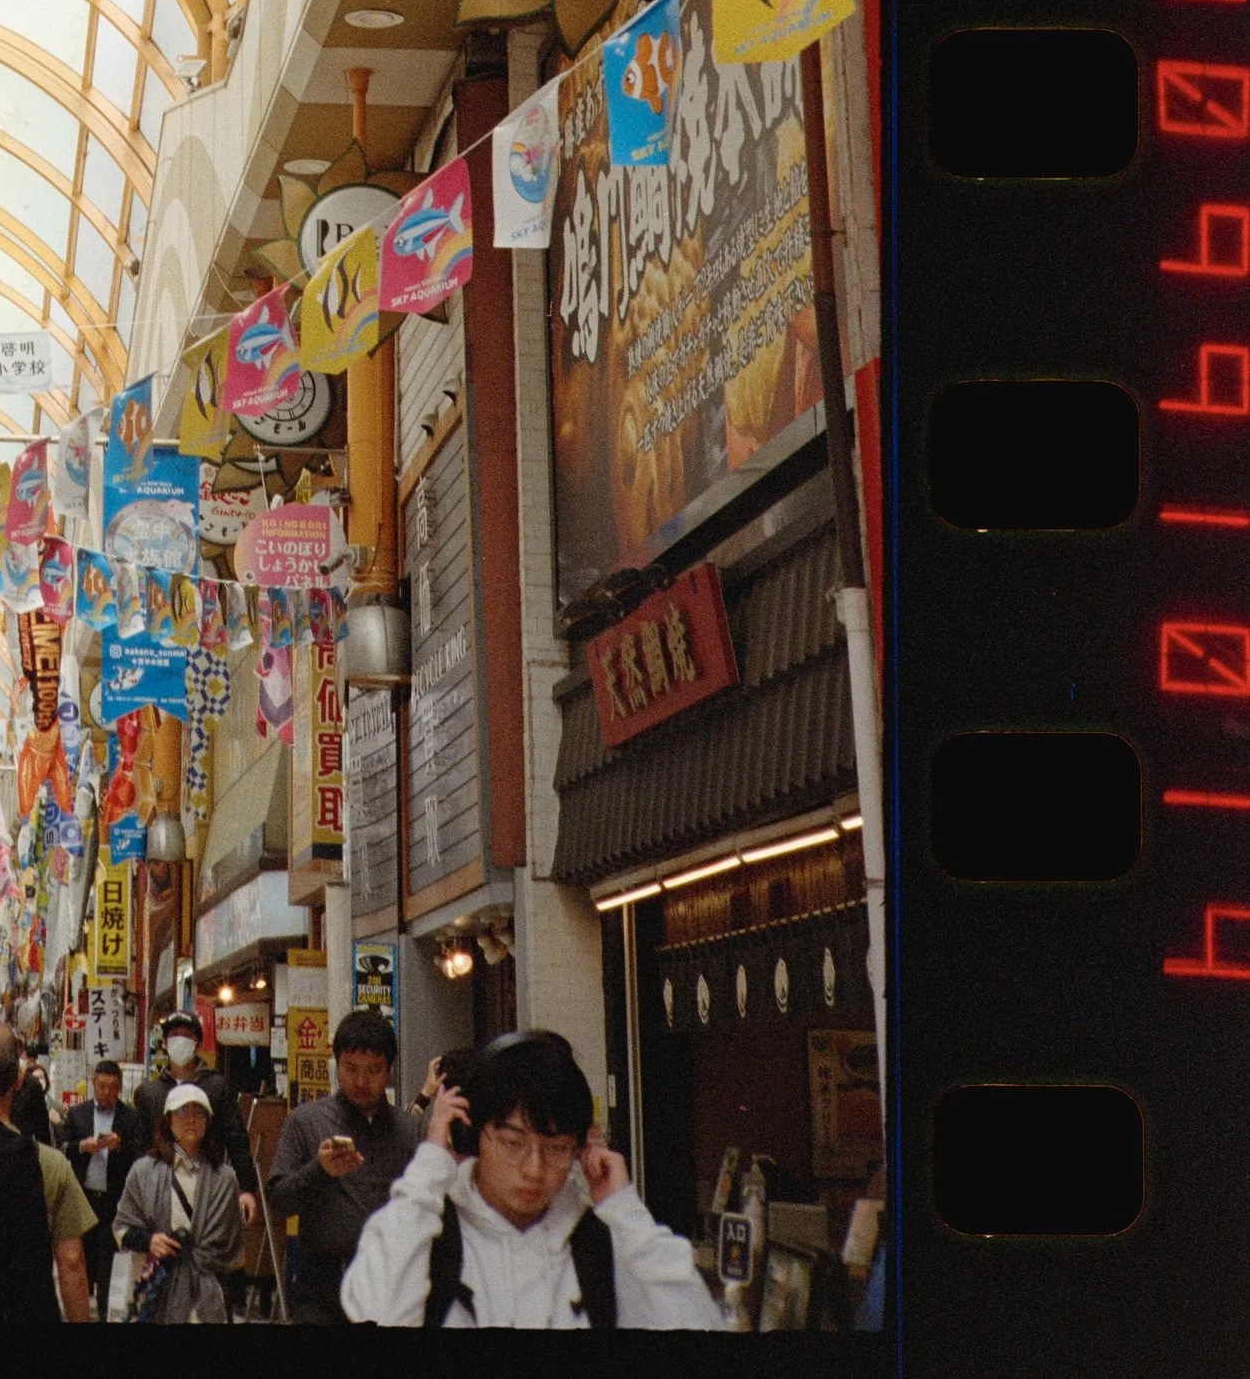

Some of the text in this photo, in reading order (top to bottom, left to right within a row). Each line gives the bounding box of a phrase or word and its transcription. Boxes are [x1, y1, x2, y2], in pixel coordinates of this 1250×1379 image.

[391, 276, 459, 308] SKY AQUARIUM
[1, 341, 36, 357] 啓明
[137, 486, 185, 495] AQUARIUM
[255, 539, 327, 557] こいのぼり
[101, 880, 125, 957] 日焼け
[357, 983, 392, 995] SECURITY
[91, 989, 110, 1058] ステーキ
[216, 1014, 265, 1033] お弁当
